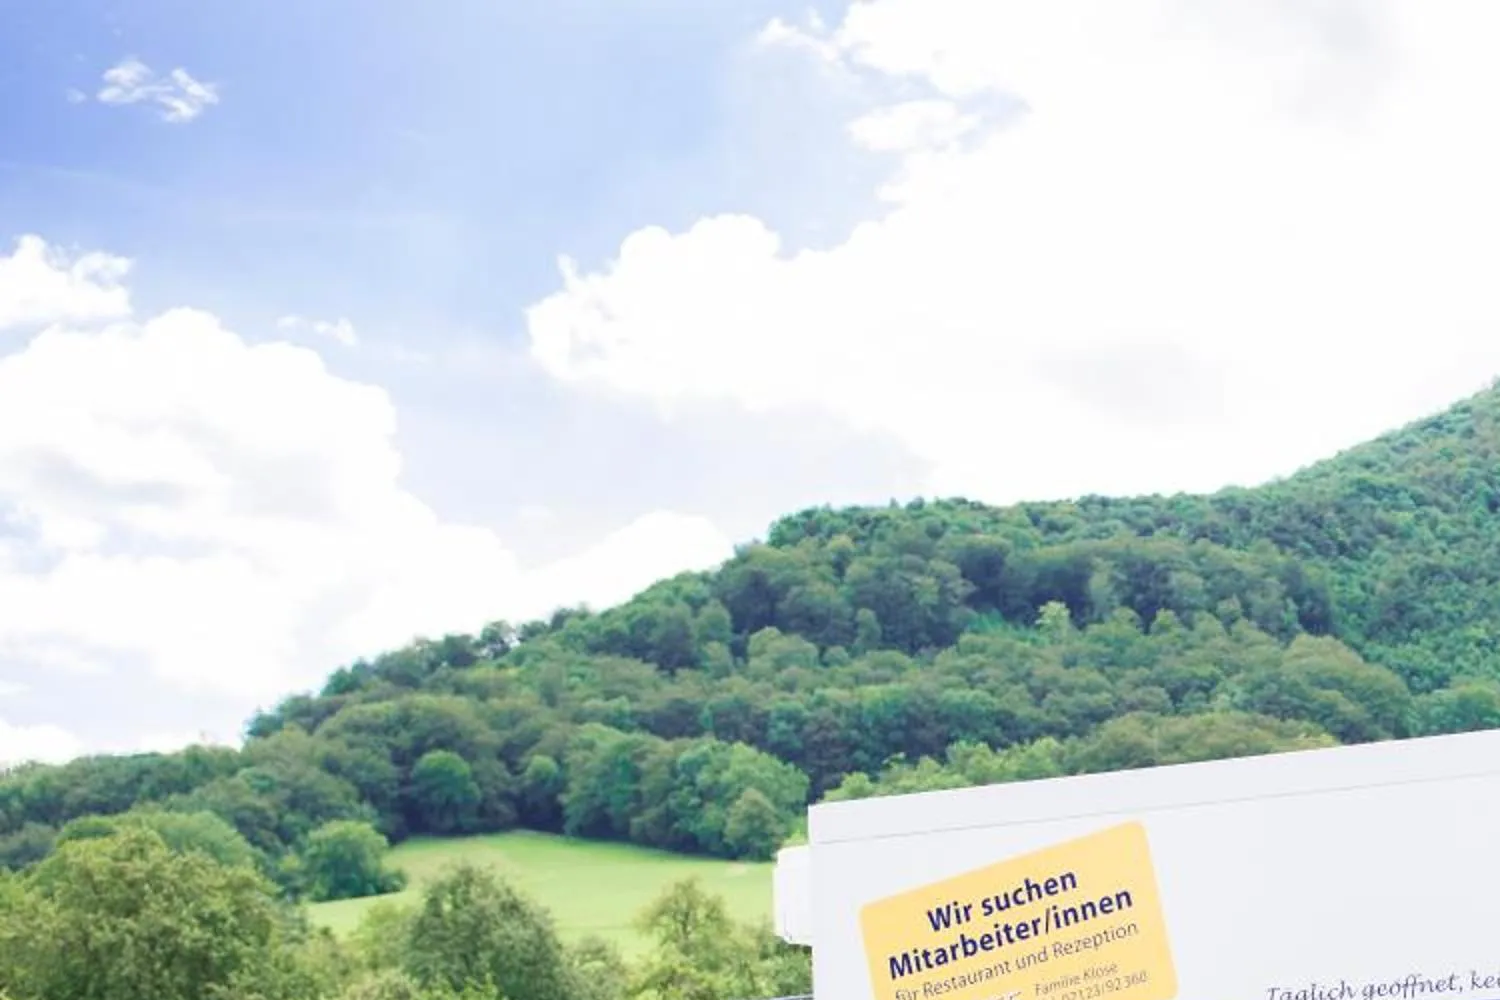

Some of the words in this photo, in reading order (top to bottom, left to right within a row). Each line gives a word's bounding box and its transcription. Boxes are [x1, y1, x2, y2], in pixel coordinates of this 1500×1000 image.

[888, 889, 1133, 980] Mitarbeiter/innen
[927, 901, 972, 932] Wir
[981, 871, 1077, 917] suchen
[923, 961, 1011, 998] Restaurant
[1016, 945, 1048, 970] und
[1052, 922, 1138, 959] Rezeption
[1034, 976, 1080, 996] Familie
